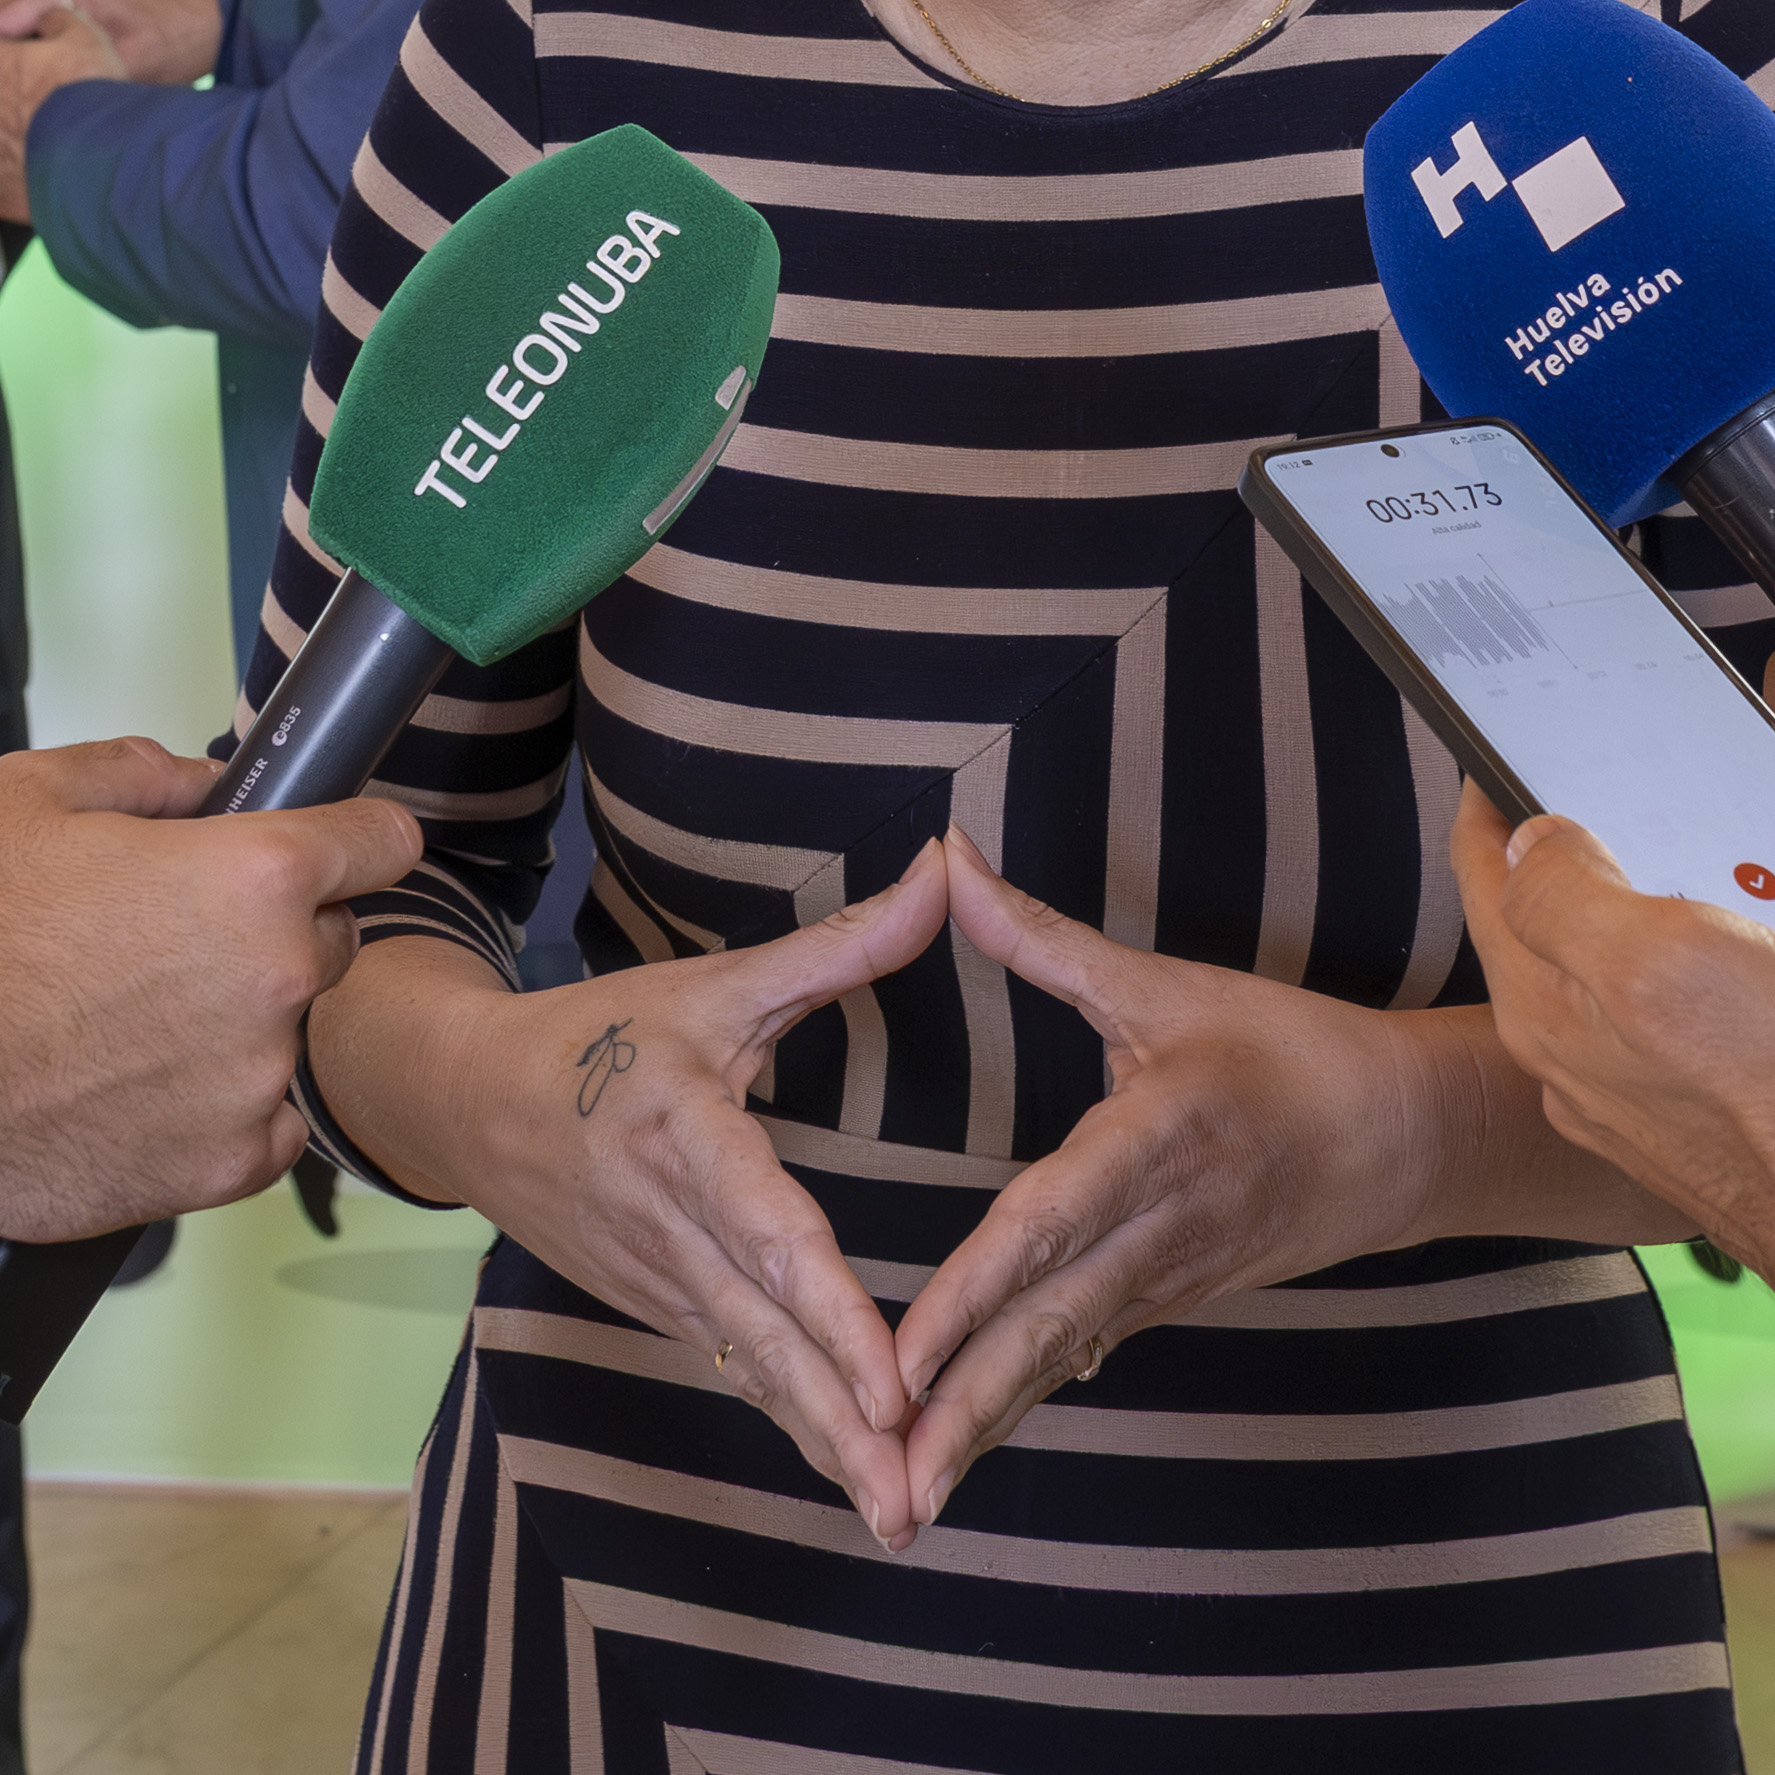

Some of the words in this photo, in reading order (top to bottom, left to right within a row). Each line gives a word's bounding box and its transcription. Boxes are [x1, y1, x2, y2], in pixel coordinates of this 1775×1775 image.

[414, 208, 682, 510] TELEONUBA
[1504, 272, 1612, 361] Huelva
[1523, 267, 1684, 387] Televisión
[1365, 482, 1503, 523] 00:31.73
[225, 757, 269, 815] HEISER
